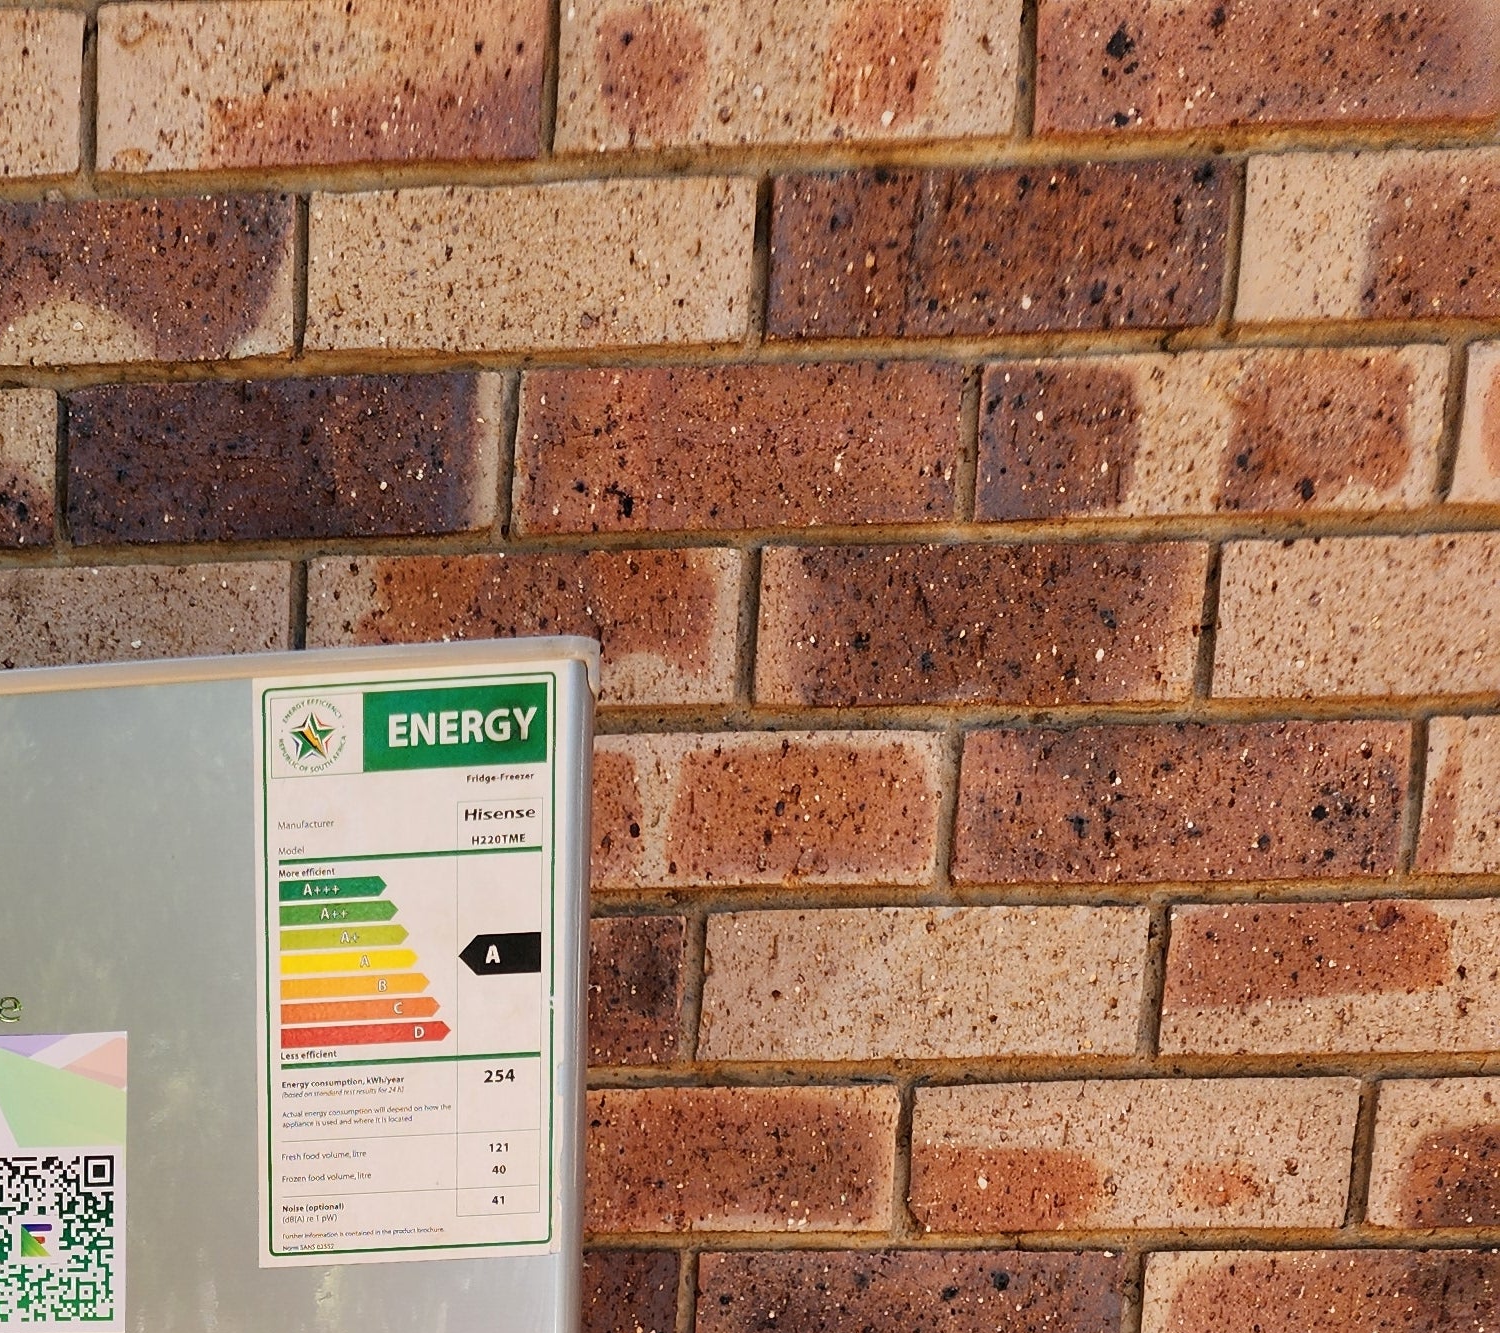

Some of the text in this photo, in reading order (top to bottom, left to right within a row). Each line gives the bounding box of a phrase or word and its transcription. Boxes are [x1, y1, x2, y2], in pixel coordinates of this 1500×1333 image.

[388, 706, 537, 748] ENERGY
[466, 772, 535, 784] Fridge-Freezer
[464, 807, 536, 821] Hisense
[277, 818, 335, 830] Manufacturer
[471, 833, 526, 846] H220TME
[278, 846, 305, 855] Model
[278, 867, 335, 878] More efficient
[303, 883, 340, 896] A+++
[320, 907, 348, 920] A++
[340, 931, 360, 943] A+
[484, 945, 501, 964] A
[359, 955, 371, 968] A
[377, 979, 387, 992] B
[393, 1001, 404, 1014] C
[413, 1026, 425, 1039] D
[280, 1049, 337, 1061] Less efficient
[483, 1068, 515, 1083] 254
[281, 1081, 309, 1089] Energy
[310, 1078, 365, 1088] consumption,
[488, 1142, 510, 1152] 121
[281, 1152, 302, 1161] Fresh
[303, 1151, 320, 1160] food
[352, 1150, 367, 1158] litre
[491, 1165, 506, 1175] 40
[281, 1175, 306, 1183] Frozen
[308, 1174, 325, 1182] food
[357, 1172, 372, 1180] litre
[491, 1195, 506, 1205] 41
[282, 1203, 345, 1213] Noise (optional)
